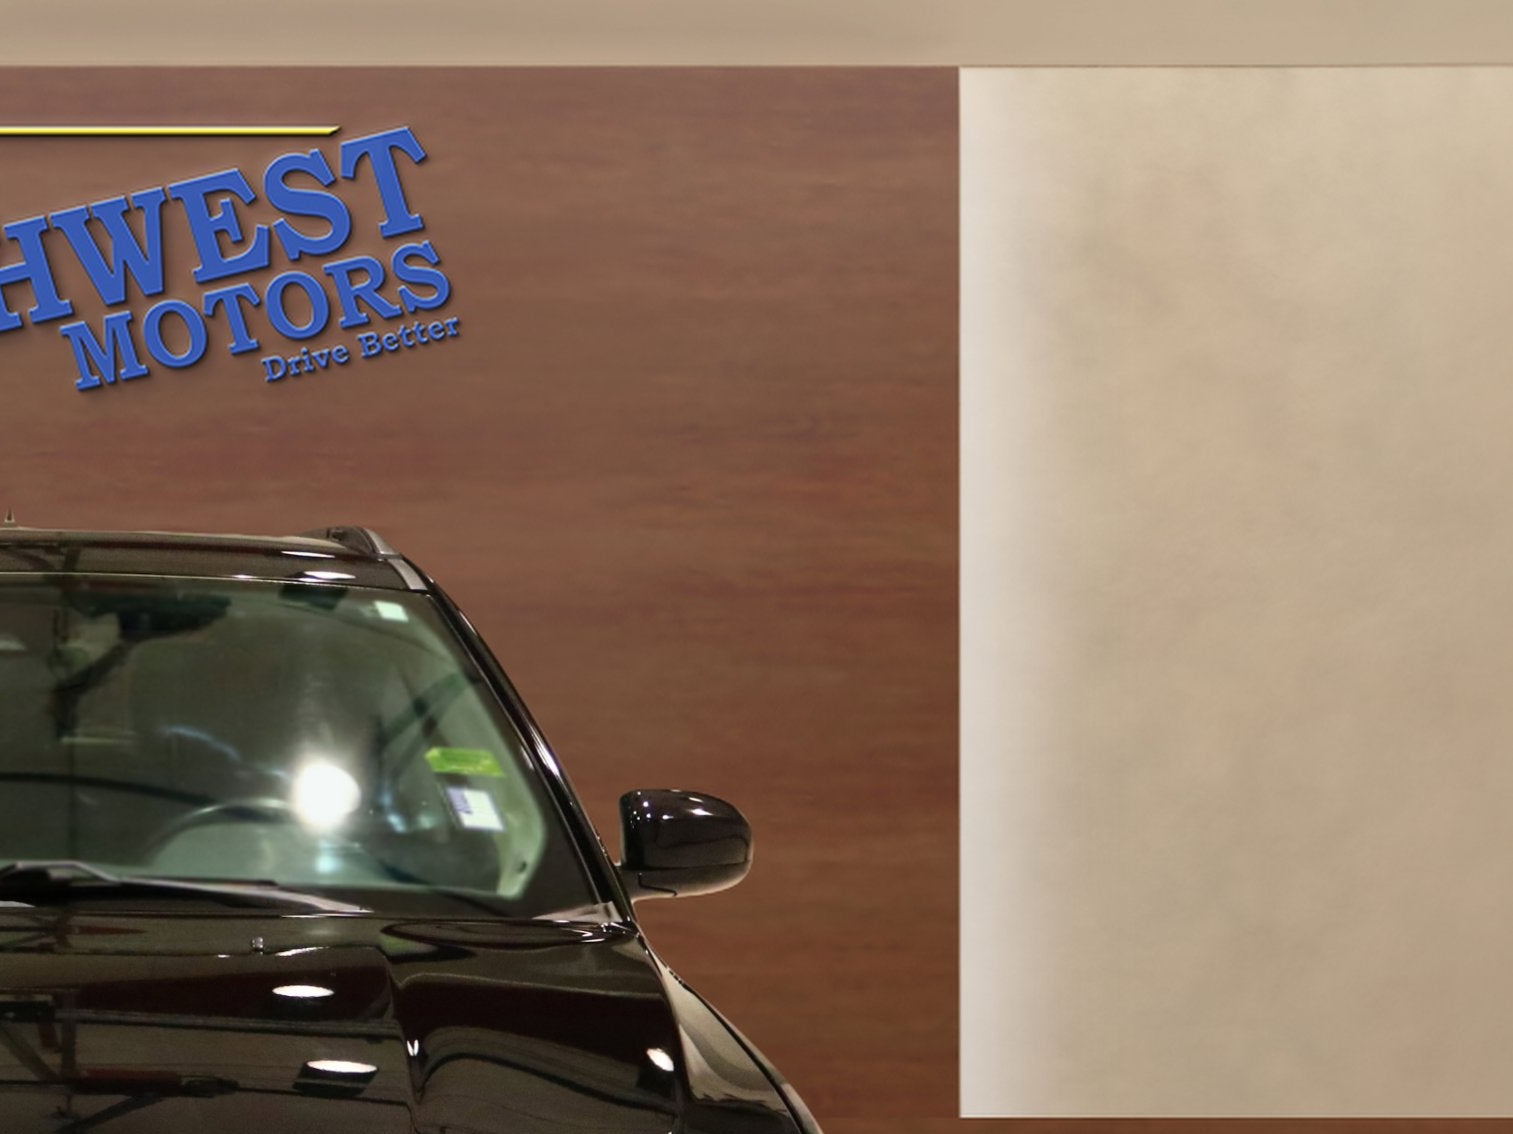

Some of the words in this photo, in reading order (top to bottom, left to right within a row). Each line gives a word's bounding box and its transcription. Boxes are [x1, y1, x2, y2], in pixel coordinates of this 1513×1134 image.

[60, 242, 452, 391] MOTORS
[261, 345, 349, 382] Drive
[357, 316, 460, 358] Better
